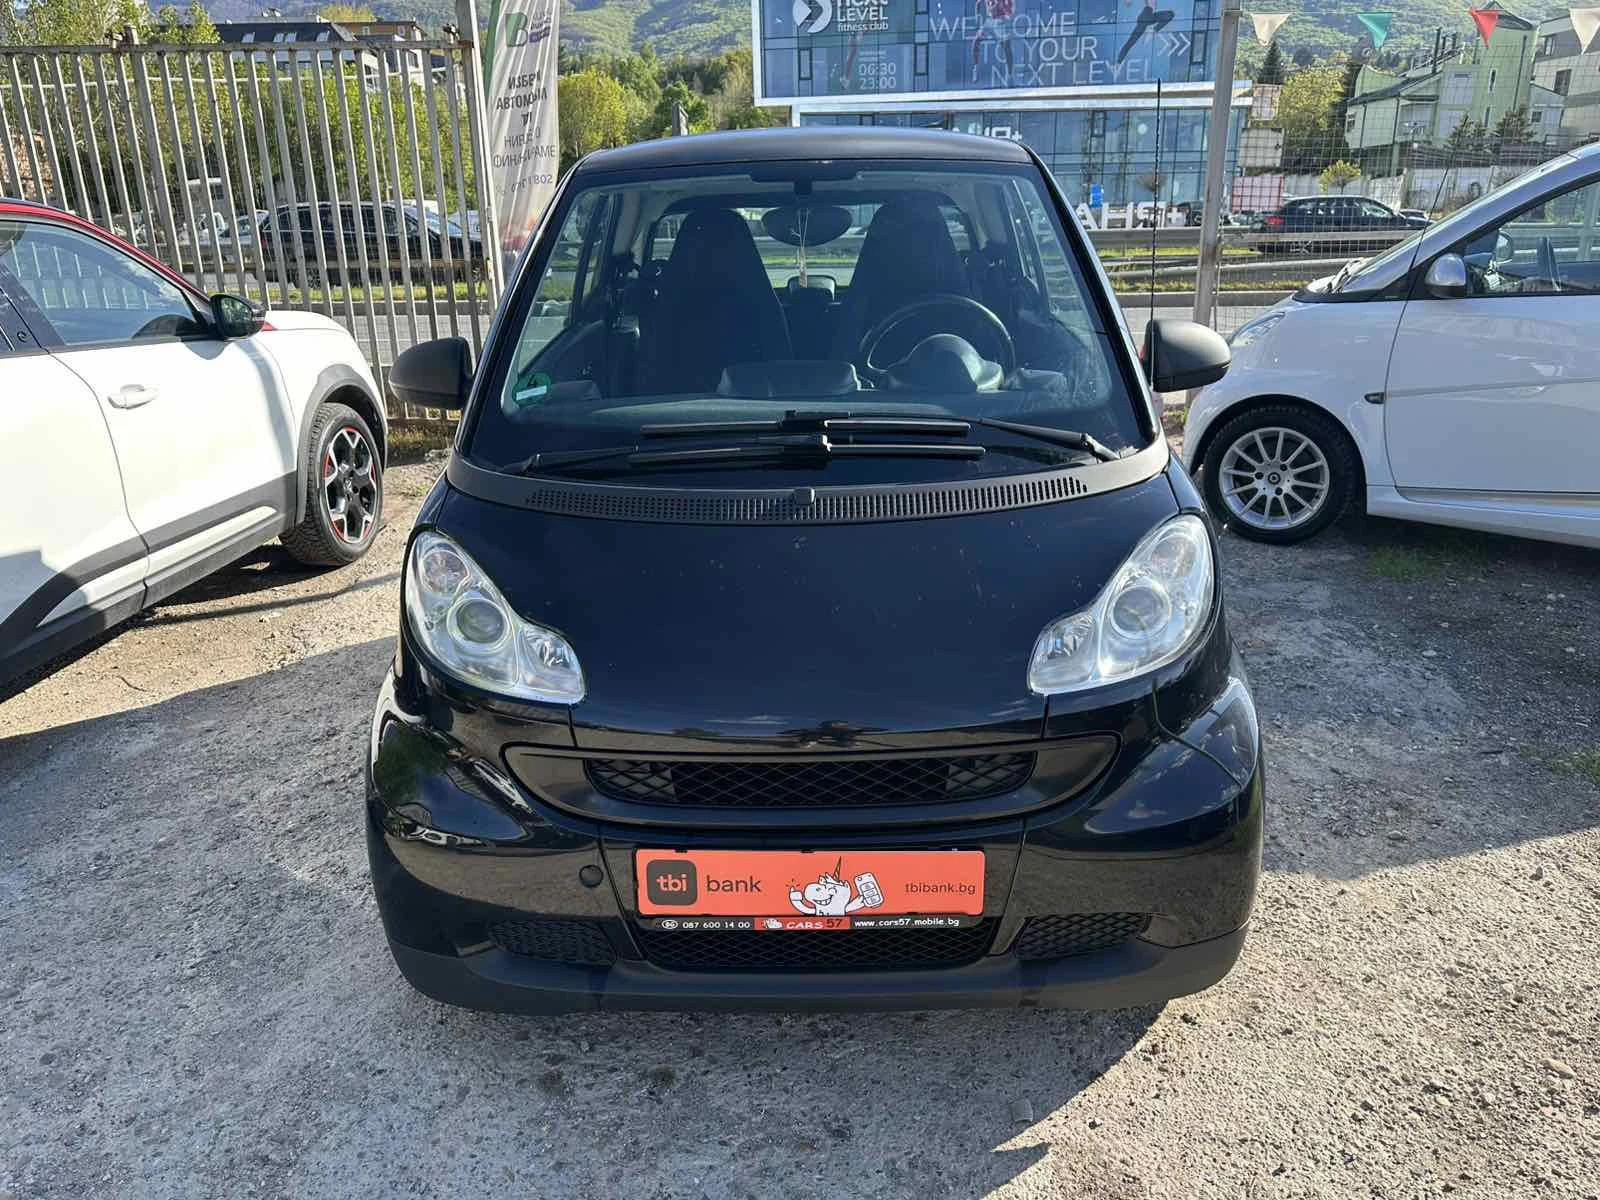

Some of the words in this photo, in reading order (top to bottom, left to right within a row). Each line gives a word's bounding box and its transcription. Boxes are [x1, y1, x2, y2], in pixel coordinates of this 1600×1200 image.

[837, 6, 889, 21] LEVEL
[1023, 35, 1098, 63] YOUR
[858, 62, 897, 76] 06:30
[991, 62, 1064, 87] NEXT
[1071, 58, 1157, 85] LEVEL
[859, 76, 897, 90] 23:00
[656, 873, 688, 892] tbi
[706, 874, 762, 892] bank
[905, 882, 976, 895] tbibank.bg
[682, 921, 699, 929] 087
[703, 921, 720, 929] 600
[725, 921, 735, 929] 14
[738, 921, 750, 929] 00
[786, 921, 823, 929] CARS
[826, 918, 842, 927] 57
[854, 916, 960, 927] www.cars57.mobile.bg
